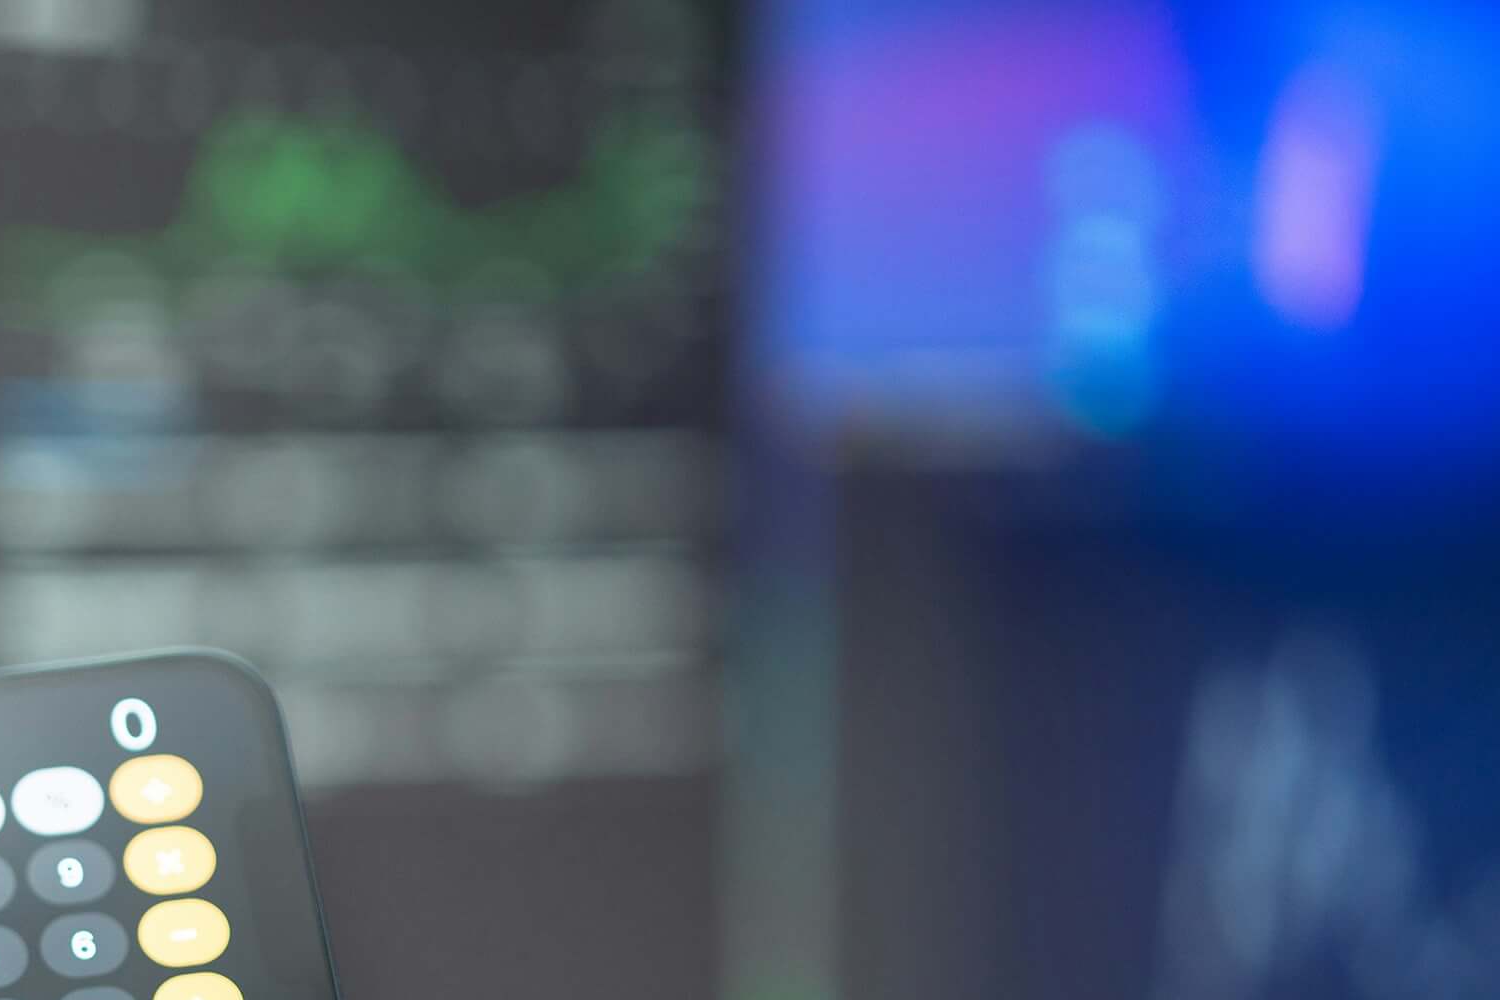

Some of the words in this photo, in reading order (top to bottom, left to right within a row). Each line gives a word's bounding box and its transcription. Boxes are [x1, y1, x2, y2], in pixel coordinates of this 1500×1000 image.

[110, 697, 158, 751] 0
[56, 857, 84, 888] 9
[70, 929, 97, 960] 6
